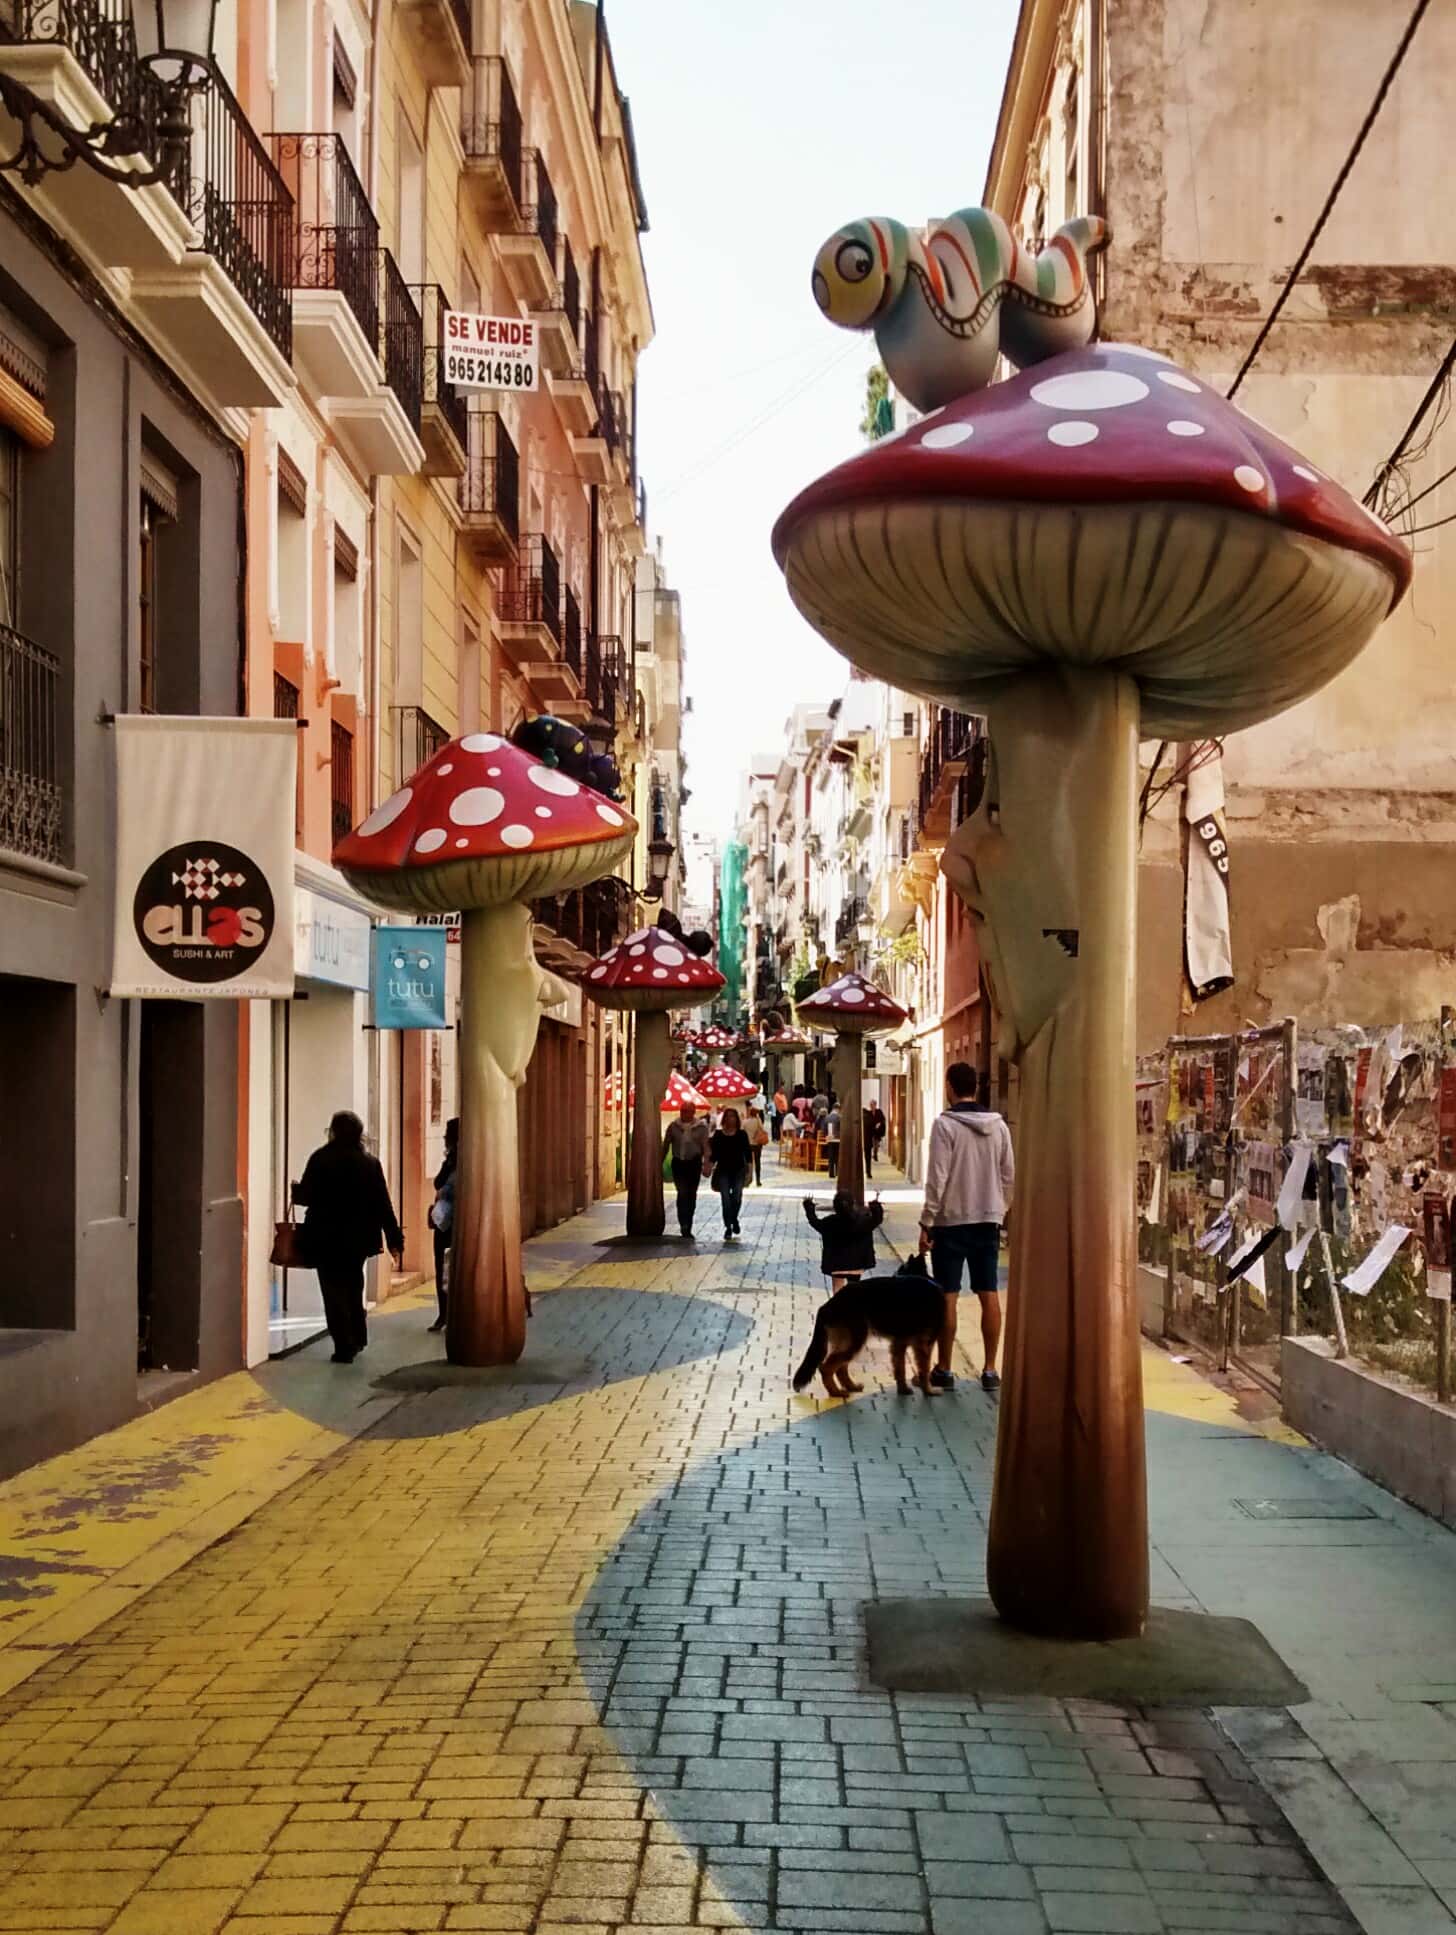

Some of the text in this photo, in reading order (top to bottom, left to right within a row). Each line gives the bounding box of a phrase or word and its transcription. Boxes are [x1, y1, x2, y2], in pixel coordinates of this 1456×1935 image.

[448, 315, 533, 346] SE VENDE
[452, 344, 495, 357] manuel
[173, 949, 235, 960] SUSHI & ART
[387, 978, 434, 999] tutu
